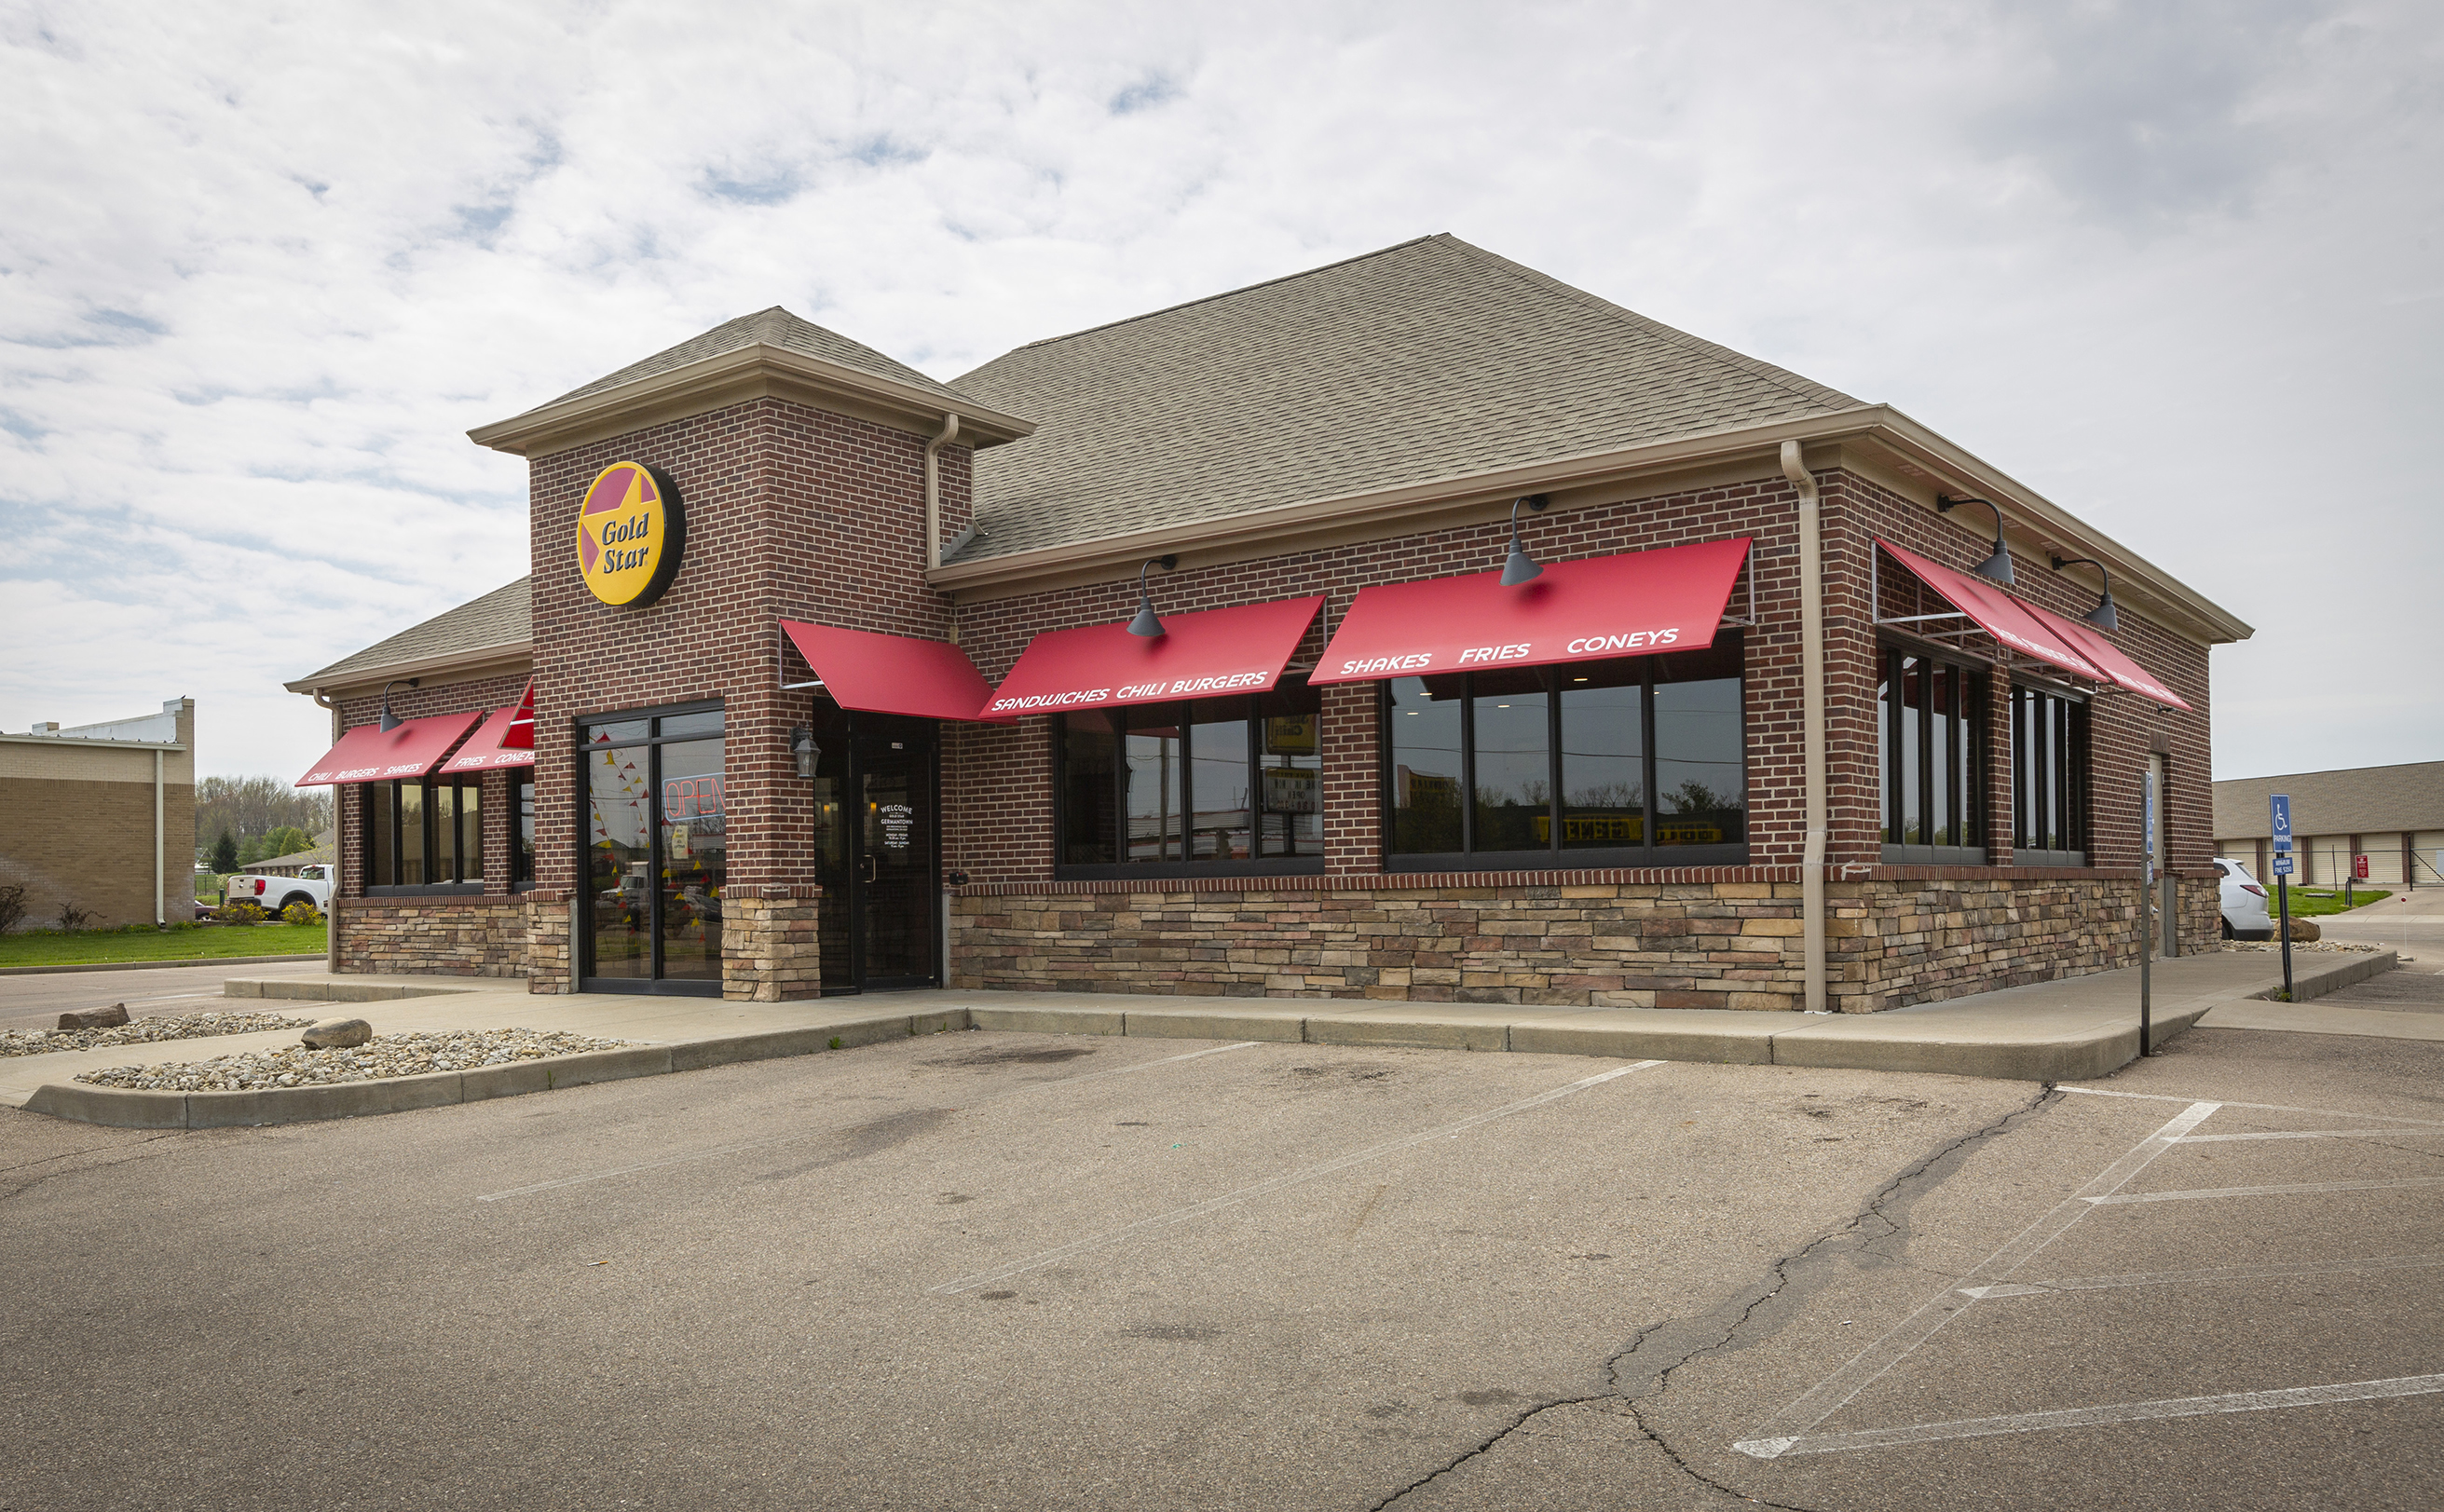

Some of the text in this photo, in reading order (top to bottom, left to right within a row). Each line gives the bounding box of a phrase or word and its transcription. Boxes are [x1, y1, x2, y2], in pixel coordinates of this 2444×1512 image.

[601, 511, 649, 546] Gold
[603, 546, 649, 574] Star
[1340, 628, 1679, 674] SHAKES FRIES CONEYS
[990, 671, 1268, 712] SANDWICHES CHILI BURGERS
[307, 763, 423, 782] CHILI BURGERS SHAKES
[454, 756, 486, 768] FRIES
[666, 776, 726, 816] OPEN
[881, 804, 913, 815] WELCOME
